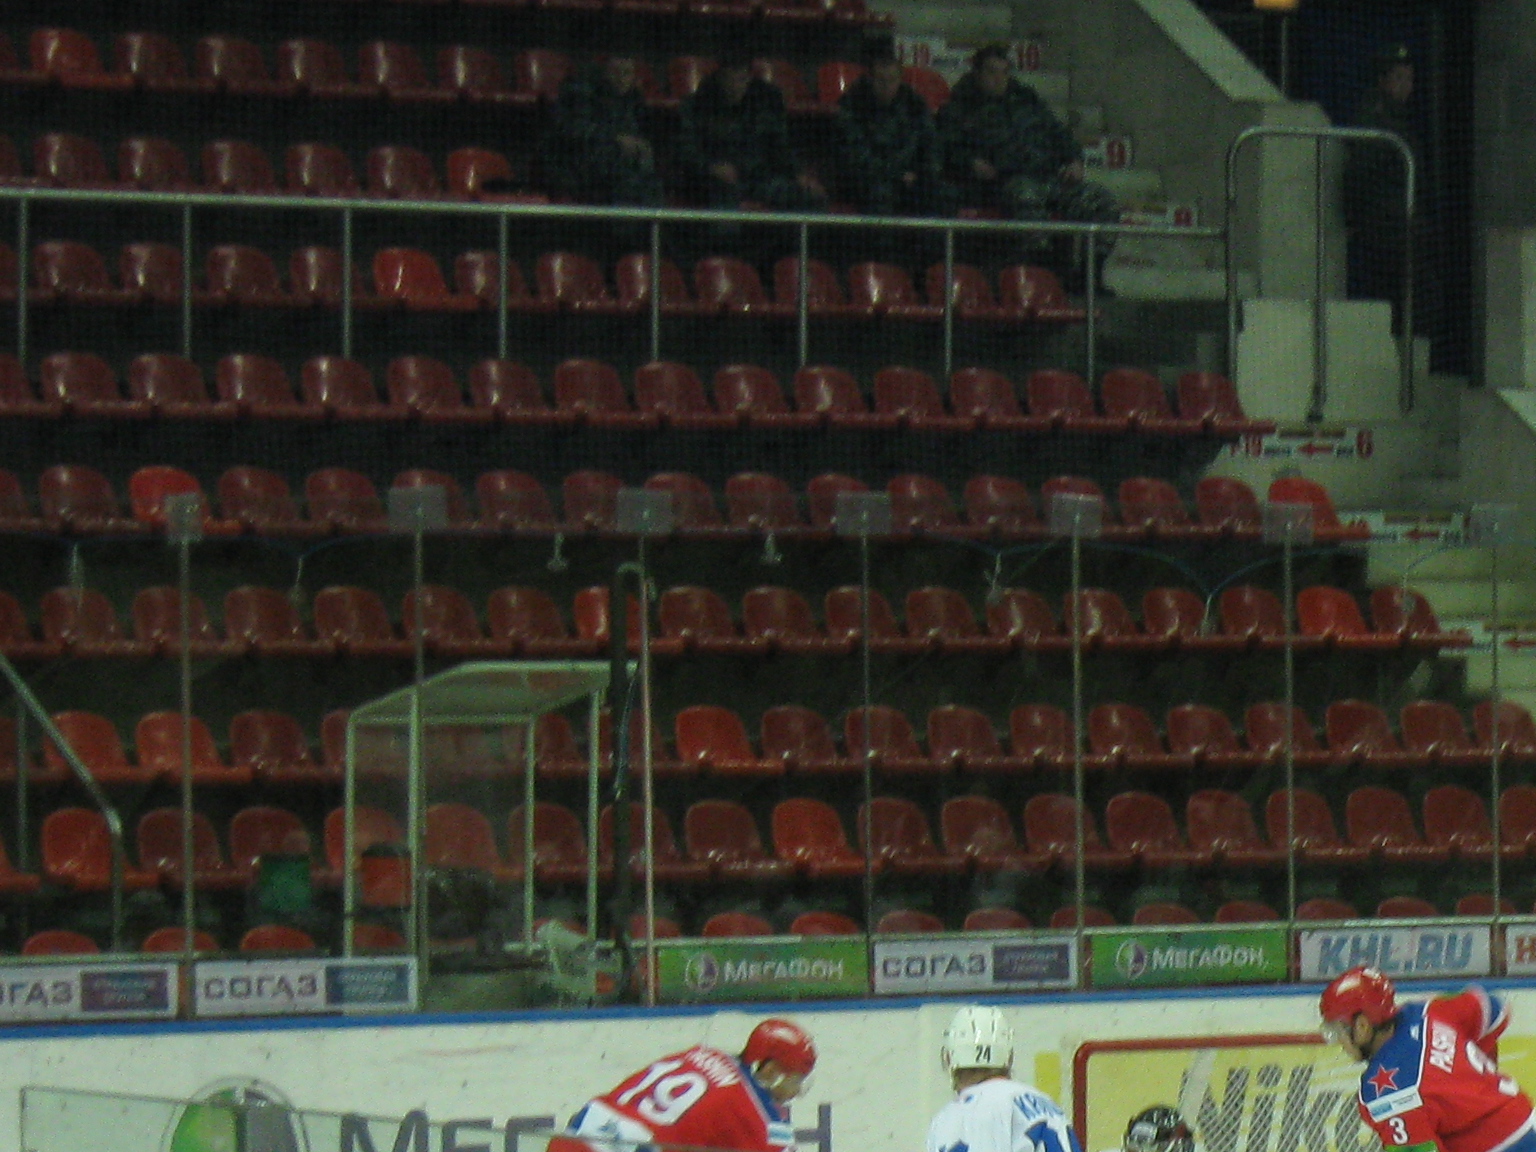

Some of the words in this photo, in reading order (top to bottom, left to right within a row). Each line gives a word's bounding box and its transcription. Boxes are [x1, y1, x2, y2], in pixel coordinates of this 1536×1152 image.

[882, 951, 986, 979] СОГАЗ
[1319, 931, 1474, 974] KHL.RU
[203, 974, 318, 1001] СОГАЗ
[975, 1044, 992, 1064] 24
[614, 1057, 710, 1126] 19
[1387, 1117, 1409, 1145] 3
